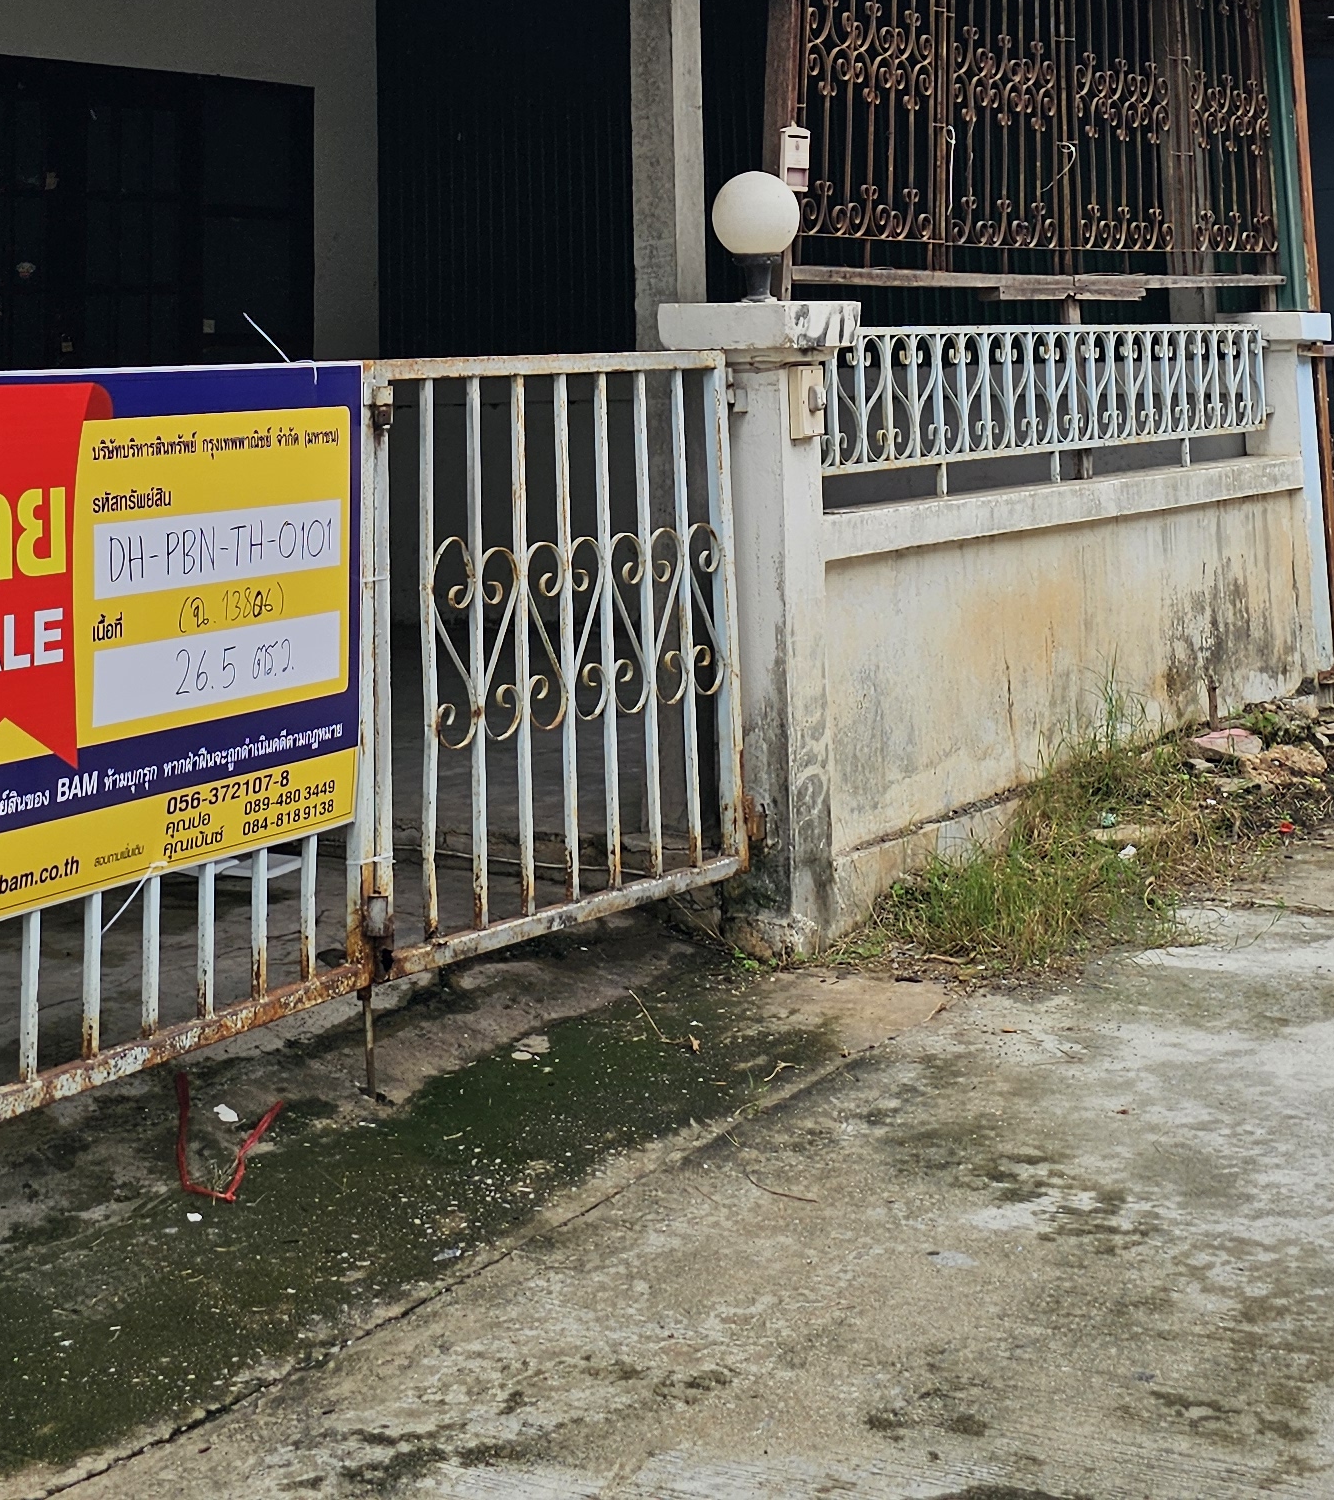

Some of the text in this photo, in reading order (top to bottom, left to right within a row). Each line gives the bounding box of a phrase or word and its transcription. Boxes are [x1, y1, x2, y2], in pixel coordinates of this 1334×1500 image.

[92, 427, 340, 461] บริษัทบริหารสินทรัพย์ กรุงเทพพาณิชย์ จำกัด (มหาชน)
[92, 487, 172, 513] รหัสทรัพย์สิน
[109, 518, 333, 583] DH-PBN-TH-0101
[92, 612, 123, 642] เนื้อที่
[175, 646, 236, 695] 26.5
[56, 771, 98, 802] BAM
[103, 768, 158, 794] ห้ามบุกรุก
[167, 770, 290, 815] 056-372107-8
[165, 812, 211, 839] คุณปอ
